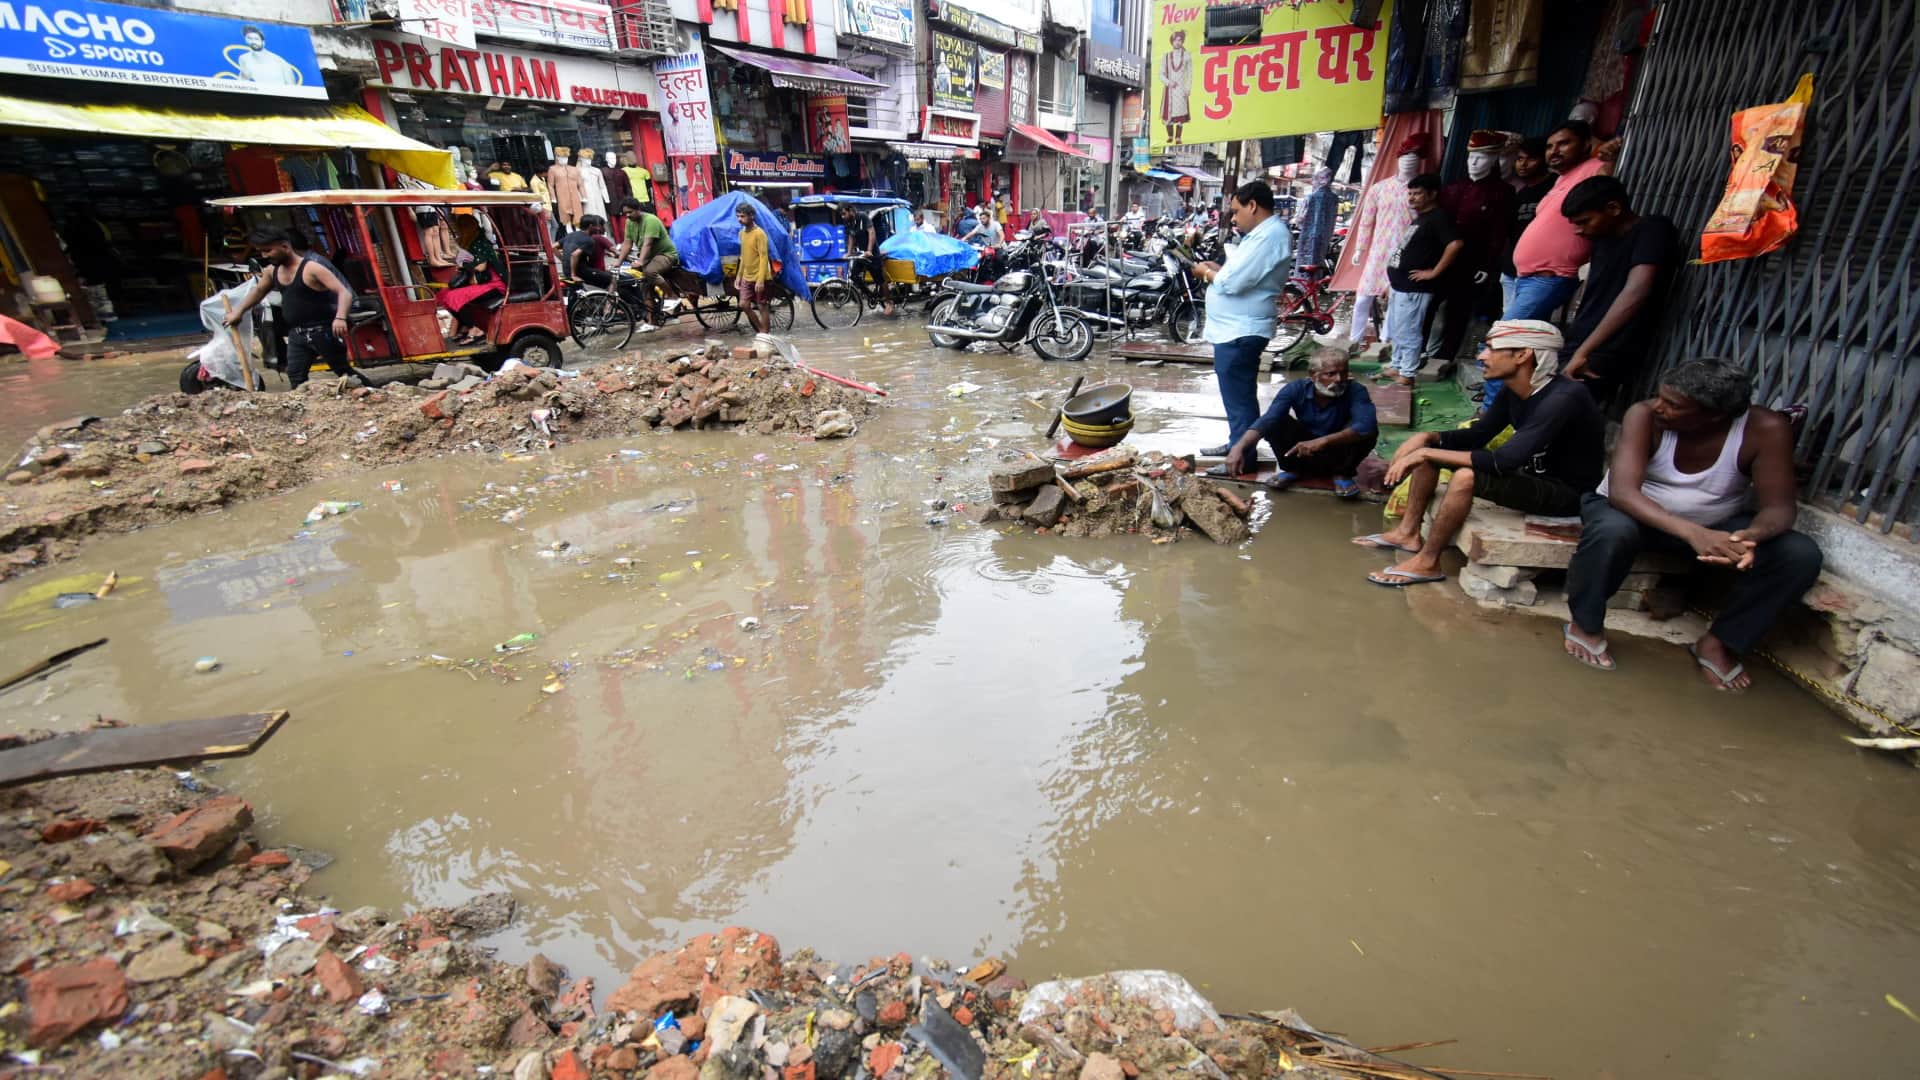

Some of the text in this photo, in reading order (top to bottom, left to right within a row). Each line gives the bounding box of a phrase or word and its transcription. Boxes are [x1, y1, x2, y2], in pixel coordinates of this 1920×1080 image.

[1161, 5, 1199, 26] New
[79, 43, 165, 66] SPORTO
[935, 33, 968, 55] ROYAL
[373, 39, 561, 100] PRATHAM
[656, 53, 699, 70] PRATHAM
[1200, 20, 1382, 120] दुल्हा घर
[27, 62, 78, 76] SUSHIL
[81, 67, 128, 81] KUMAR
[131, 73, 139, 81] &
[142, 73, 208, 88] BROTHERS
[656, 69, 703, 100] दूल्हा
[570, 85, 648, 109] COLLECTION
[679, 101, 708, 121] घर
[730, 152, 824, 172] Pratham Collection
